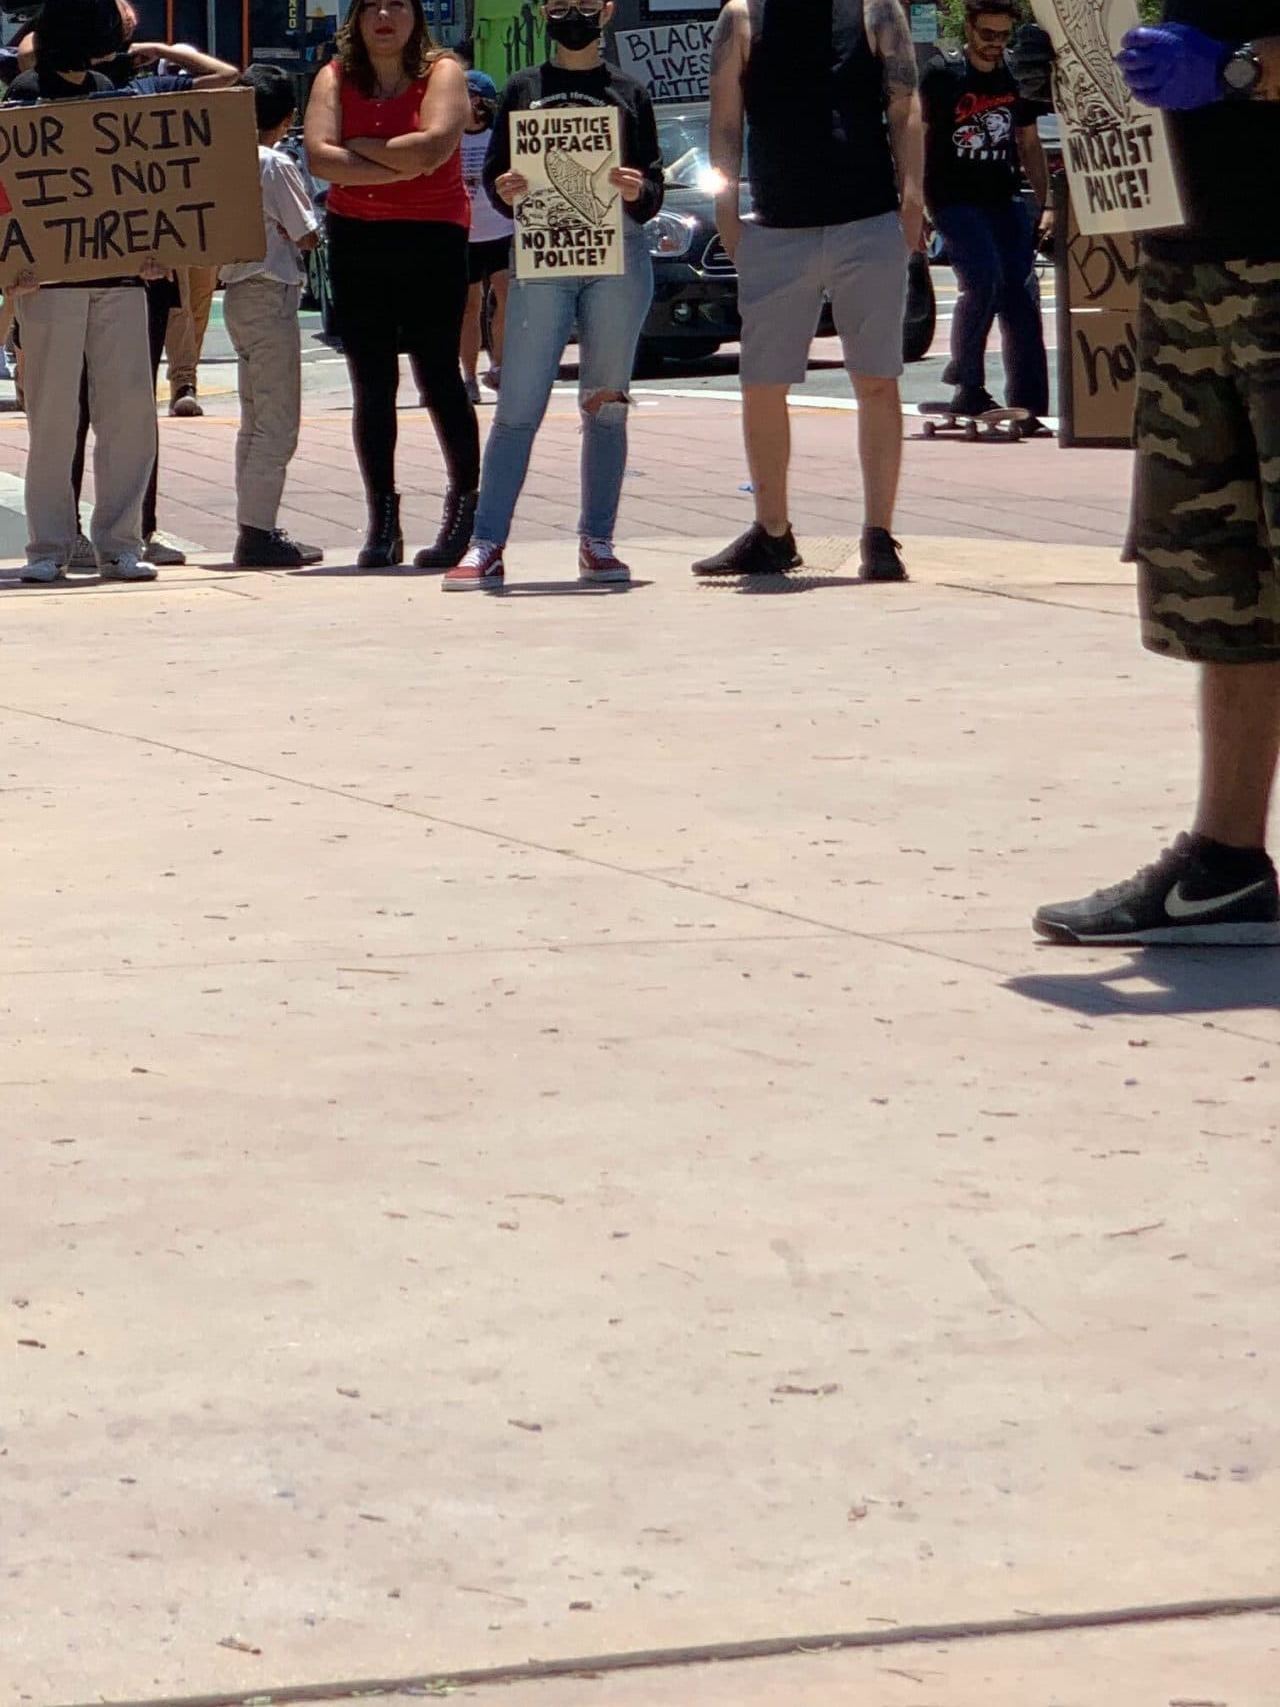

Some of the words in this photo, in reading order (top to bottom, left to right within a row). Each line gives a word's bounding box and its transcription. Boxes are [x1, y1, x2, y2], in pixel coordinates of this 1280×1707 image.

[625, 24, 714, 62] BLACK
[646, 53, 711, 80] LIVES
[92, 108, 212, 155] SKIN
[516, 118, 539, 137] NO
[541, 116, 610, 136] JUSTICE
[516, 136, 541, 155] NO
[544, 134, 613, 154] PEACE!
[1084, 124, 1153, 171] RACIST
[15, 167, 94, 208] IS
[111, 157, 200, 196] NOT
[1084, 167, 1151, 214] POLICE!
[0, 218, 35, 264] A
[43, 201, 215, 264] THREAT
[521, 231, 545, 250] NO
[548, 228, 616, 248] RACIST
[533, 248, 607, 269] POLICE!
